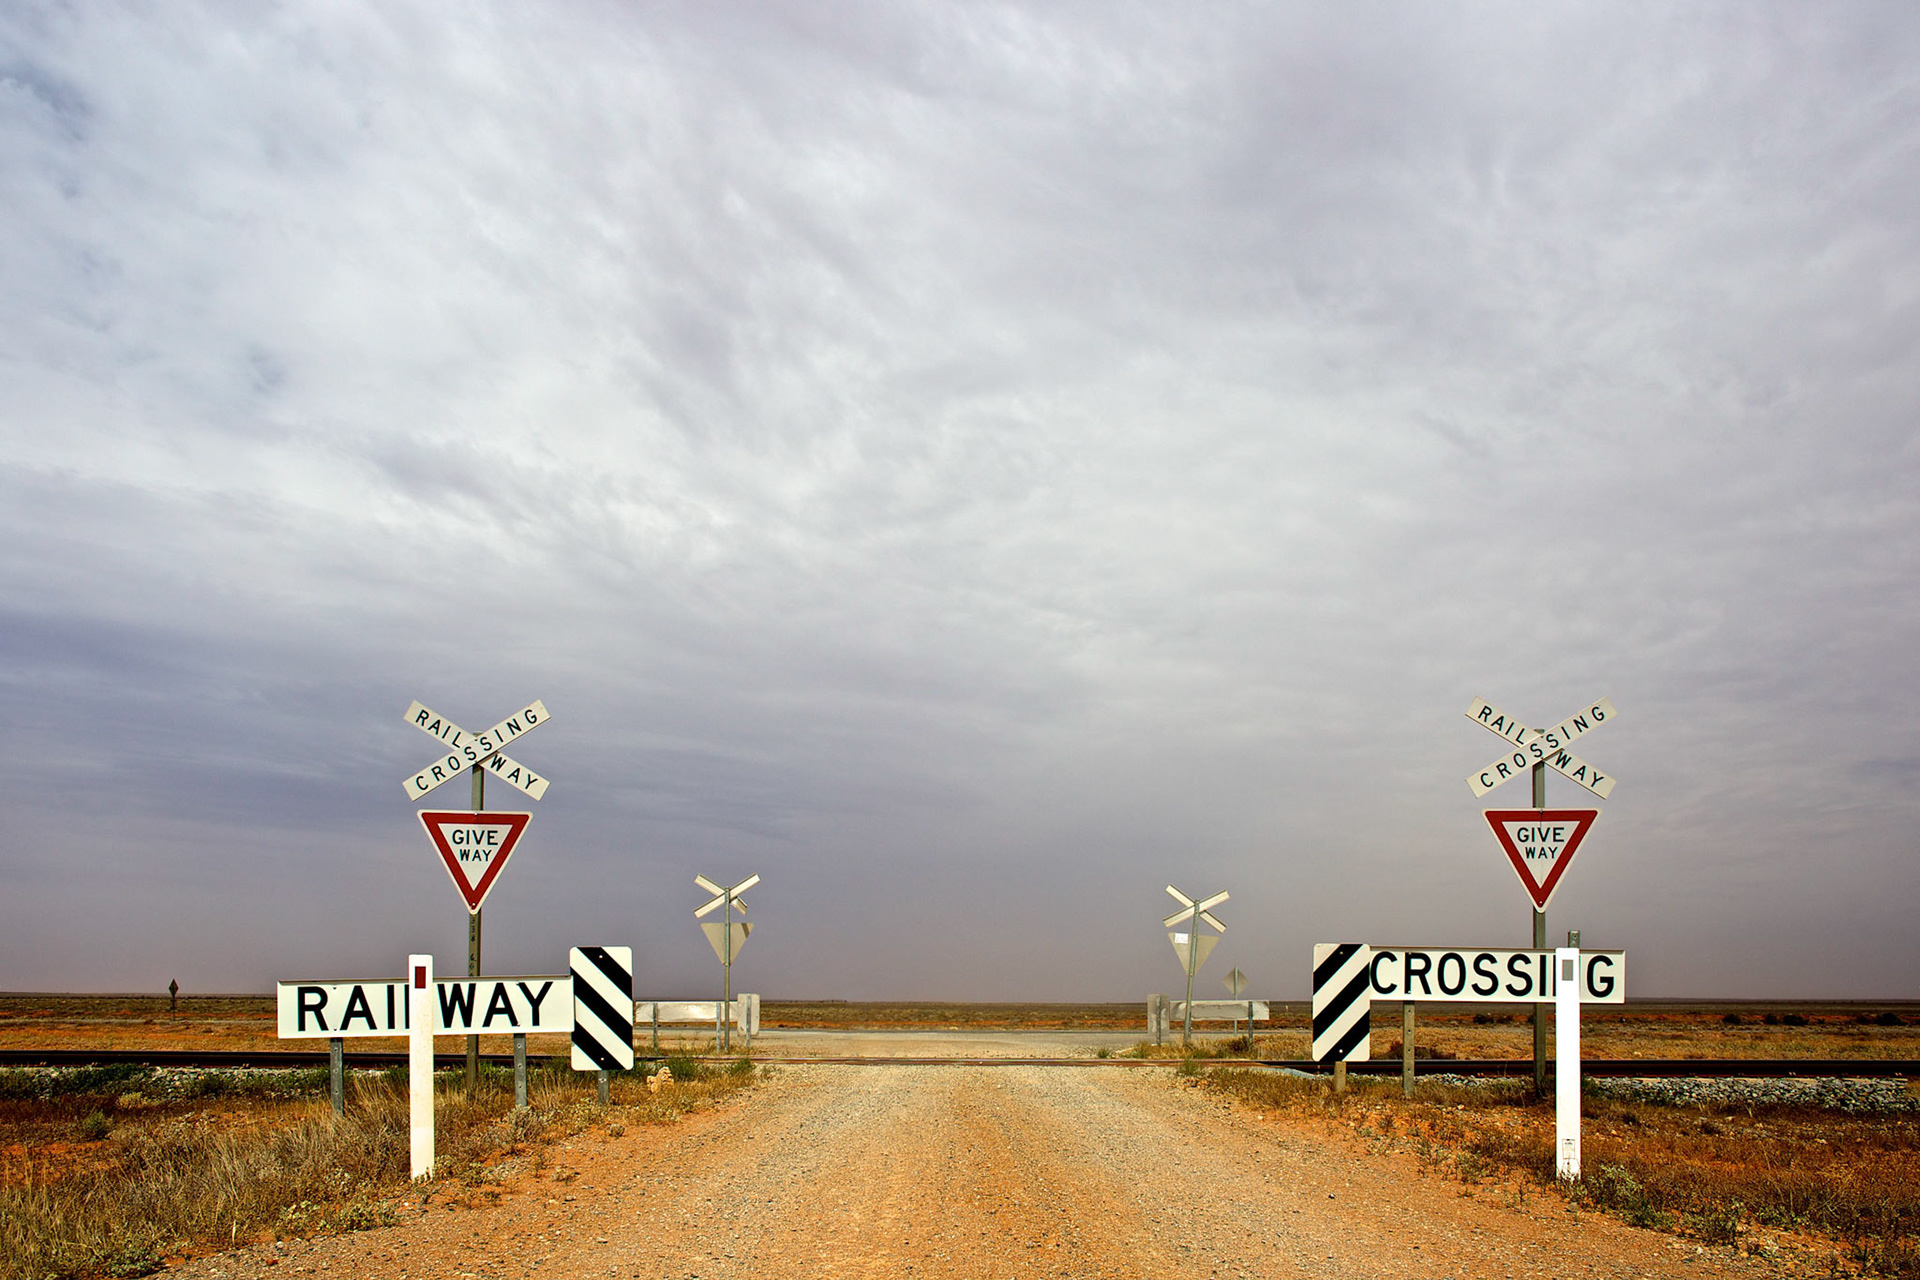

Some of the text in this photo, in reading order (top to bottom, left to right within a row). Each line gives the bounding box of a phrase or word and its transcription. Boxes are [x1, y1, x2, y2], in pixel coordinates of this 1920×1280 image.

[415, 709, 538, 790] RAIL WAY
[415, 708, 538, 791] CROSSING
[1477, 705, 1605, 788] RAIL WAY
[1480, 705, 1606, 788] CROSSING
[452, 829, 499, 846] GIVE
[459, 849, 492, 862] WAY
[1517, 827, 1565, 843] GIVE
[1525, 846, 1558, 859] WAY
[1370, 951, 1615, 998] CROSSIG
